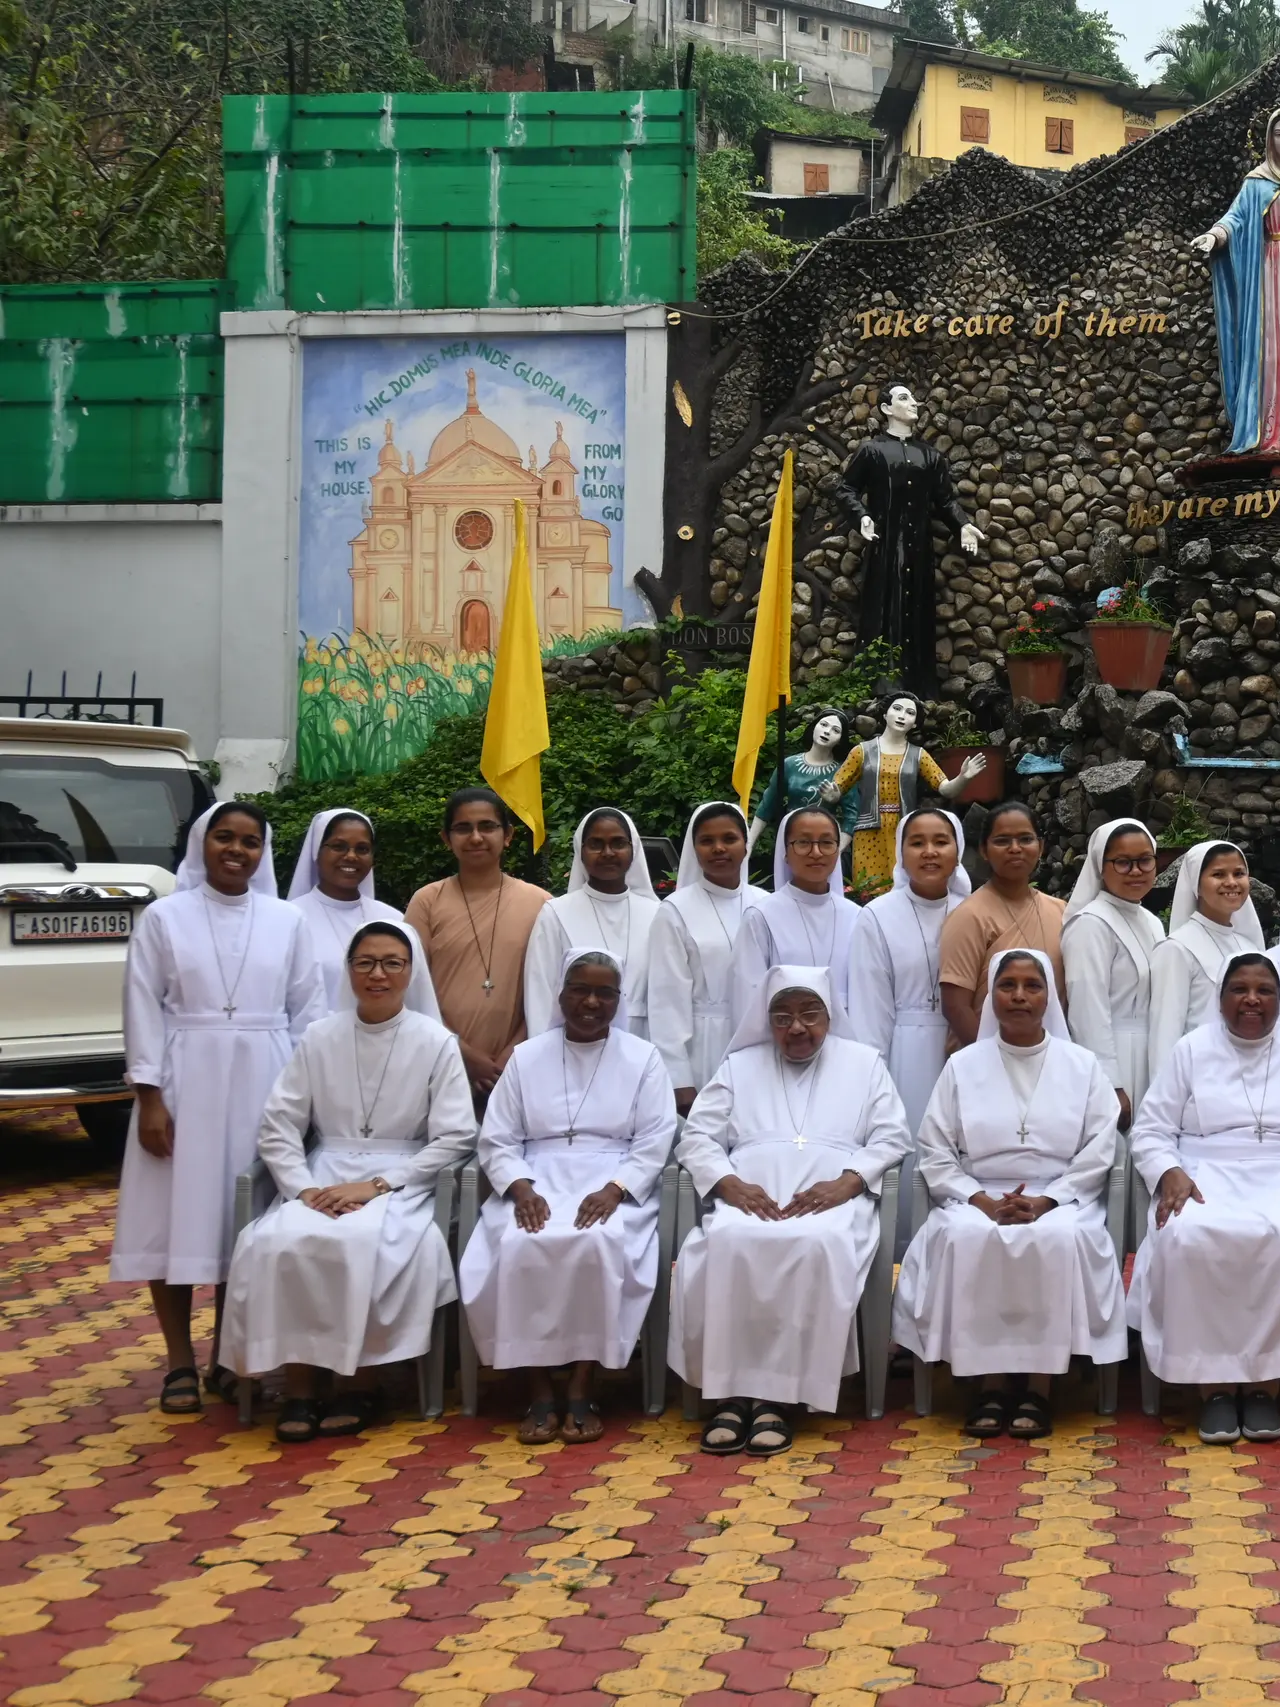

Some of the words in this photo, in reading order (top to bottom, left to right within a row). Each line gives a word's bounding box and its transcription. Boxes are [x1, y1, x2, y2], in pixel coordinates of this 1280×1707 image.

[856, 308, 928, 340] Take
[948, 312, 1014, 337] care
[1034, 300, 1069, 339] of
[1083, 307, 1168, 338] them
[388, 353, 439, 397] DOMUS
[440, 341, 471, 360] MEA
[475, 342, 511, 370] INDE
[513, 362, 566, 401] GLORIA
[314, 437, 348, 453] THIS
[357, 436, 371, 450] IS
[584, 444, 621, 460] FROM
[335, 460, 357, 475] MY
[584, 465, 607, 480] MY
[321, 481, 370, 498] HOUSE.
[582, 483, 625, 500] GLORY
[1126, 499, 1175, 529] they
[1177, 496, 1228, 519] are
[1234, 488, 1280, 518] my
[31, 914, 127, 934] AS01FA6196
